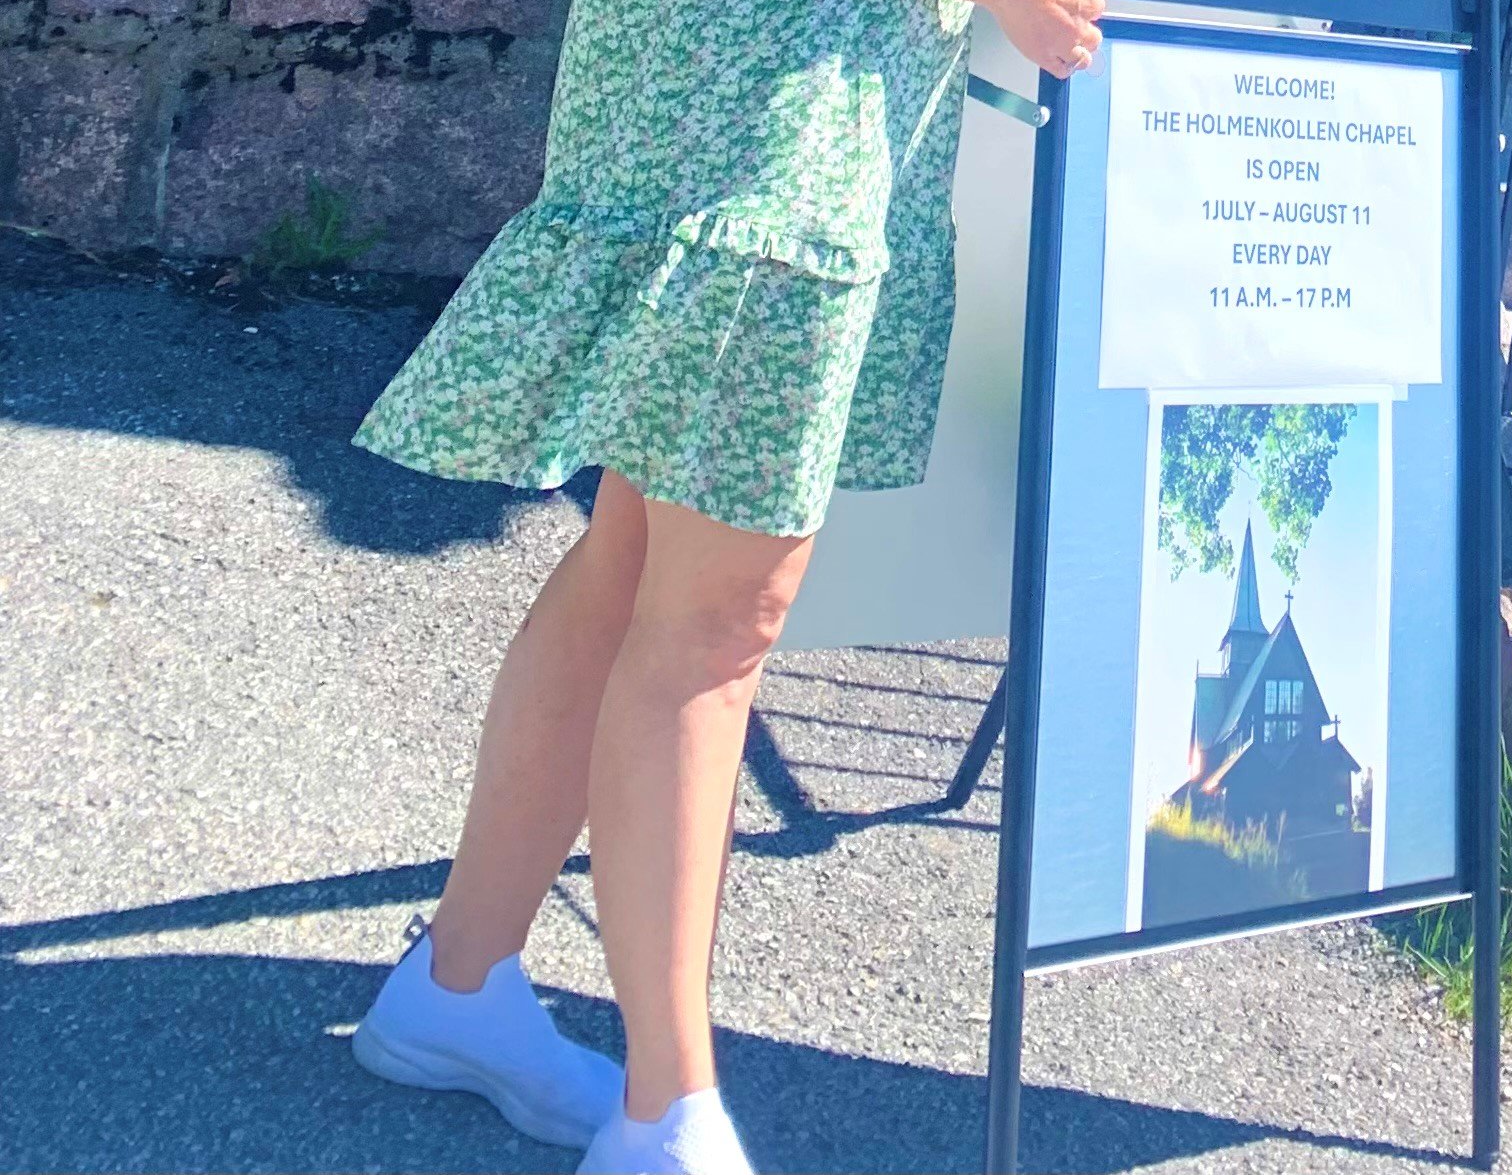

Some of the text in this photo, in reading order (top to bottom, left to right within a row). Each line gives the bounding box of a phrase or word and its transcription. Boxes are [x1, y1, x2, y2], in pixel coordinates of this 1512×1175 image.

[1234, 73, 1335, 101] WELCOME!
[1142, 110, 1417, 147] THE HOLMENKOLLEN CHAPEL
[1246, 158, 1320, 183] IS OPEN
[1272, 201, 1348, 225] AUGUST
[1351, 205, 1371, 226] 11
[1232, 243, 1333, 267] EVERY DAY
[1209, 286, 1230, 308] 11
[1235, 286, 1278, 309] A.M.
[1295, 287, 1317, 309] 17
[1320, 287, 1352, 309] P.M
